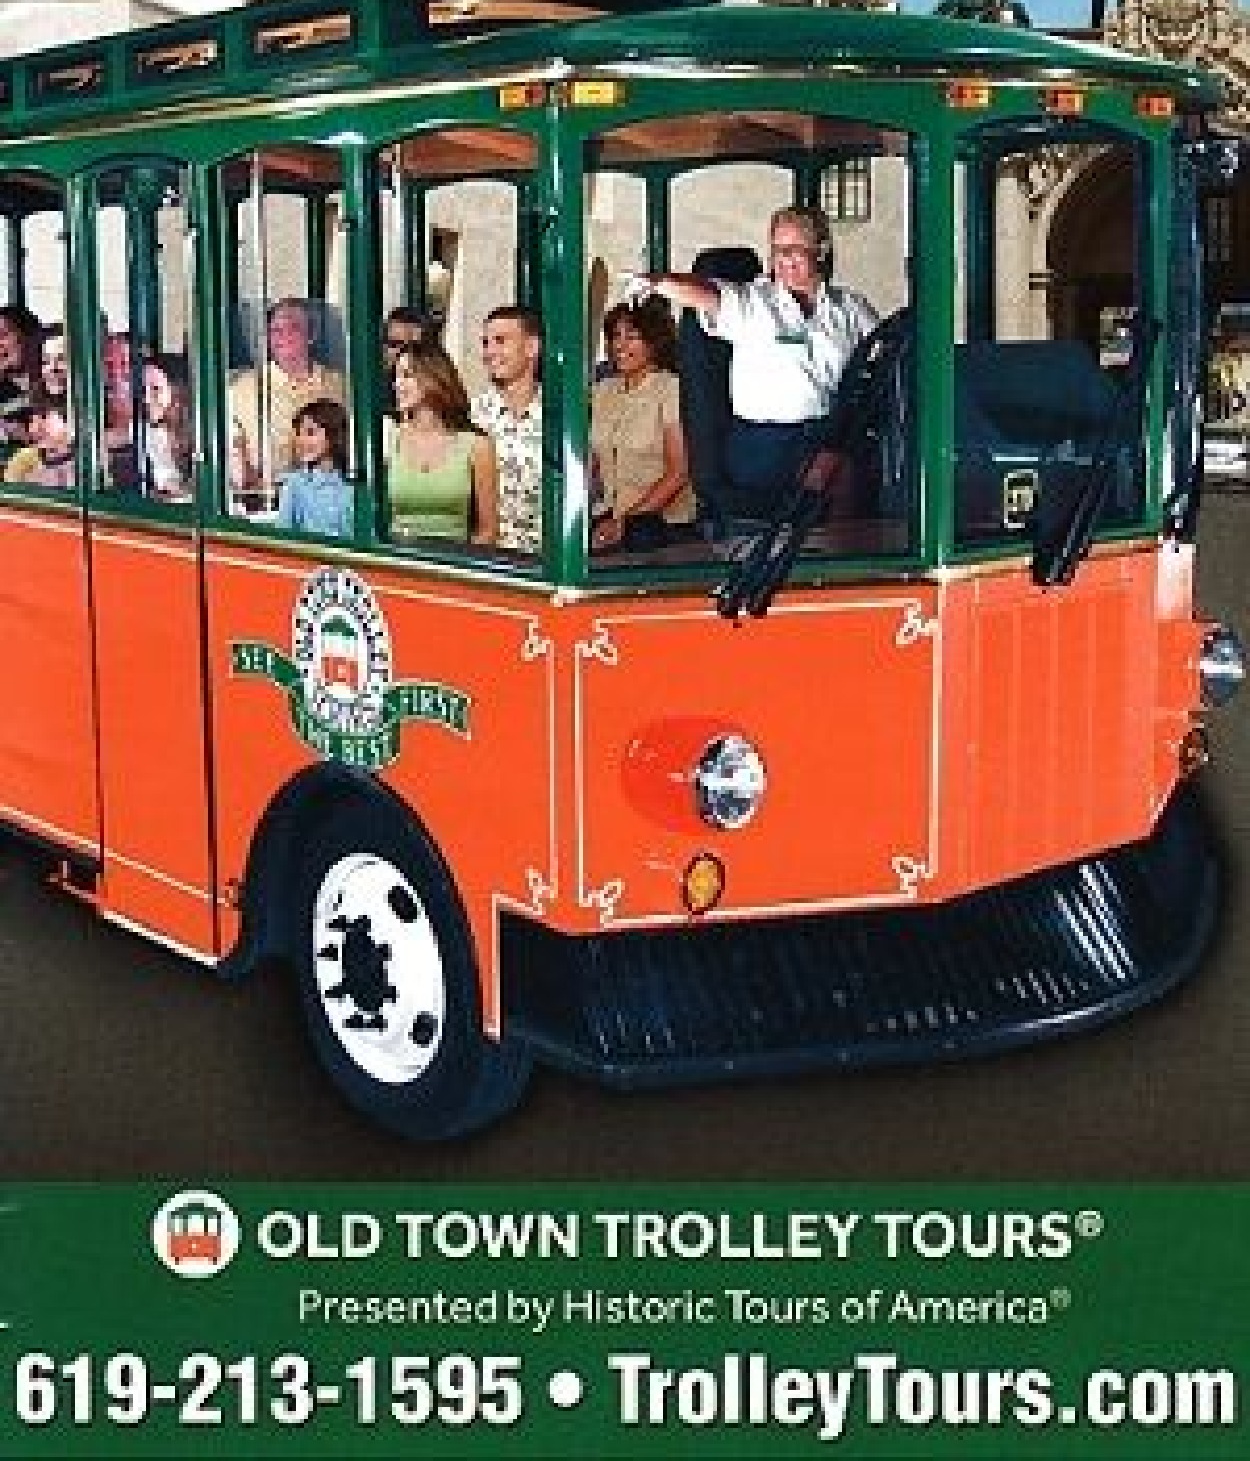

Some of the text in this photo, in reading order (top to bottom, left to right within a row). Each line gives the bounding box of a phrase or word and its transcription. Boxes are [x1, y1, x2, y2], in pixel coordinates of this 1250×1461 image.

[257, 1210, 380, 1259] OLD
[395, 1210, 580, 1259] TOWN
[595, 1210, 859, 1259] TROLLEY
[298, 1289, 497, 1325] Presented
[506, 1289, 555, 1333] by
[565, 1289, 714, 1325] Historic
[724, 1289, 831, 1325] Tours
[840, 1289, 883, 1325] of
[15, 1352, 1235, 1441] 619-213-1595 TrolleyTours.com
